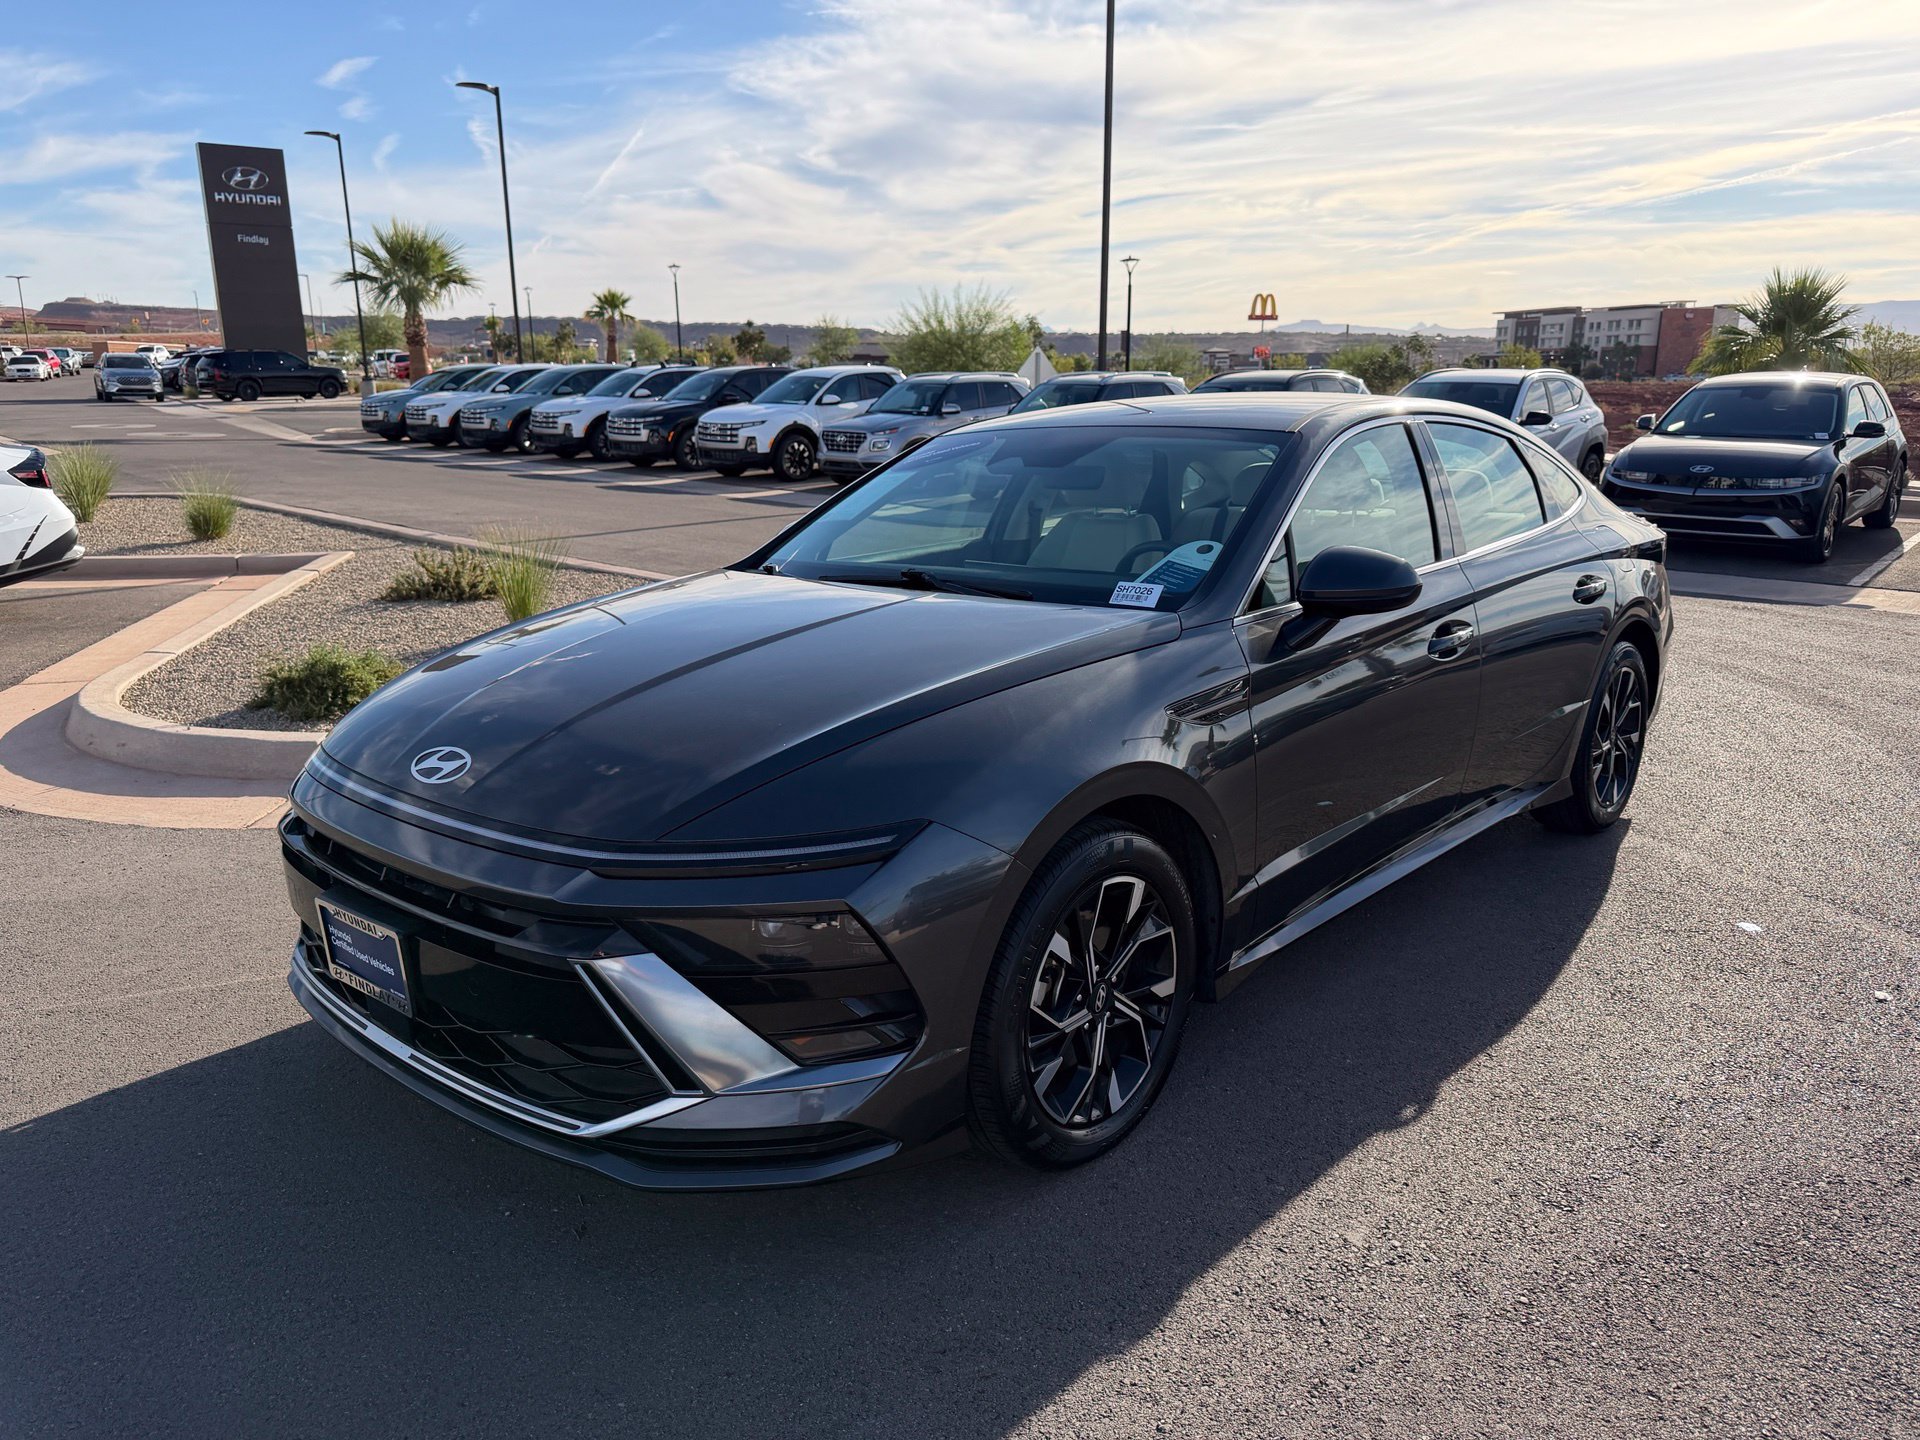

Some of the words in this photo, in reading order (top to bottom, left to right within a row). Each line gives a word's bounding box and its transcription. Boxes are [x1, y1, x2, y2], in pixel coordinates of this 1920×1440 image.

[214, 192, 282, 206] HYUNDAI
[237, 234, 269, 246] Findlay
[1116, 585, 1154, 596] SH7026
[336, 908, 377, 935] HYUNDAI
[328, 924, 353, 944] Hyundai
[331, 935, 355, 956] Certified
[353, 948, 369, 964] Used
[369, 956, 395, 976] Vehicles
[349, 974, 391, 1004] FINDLAY
